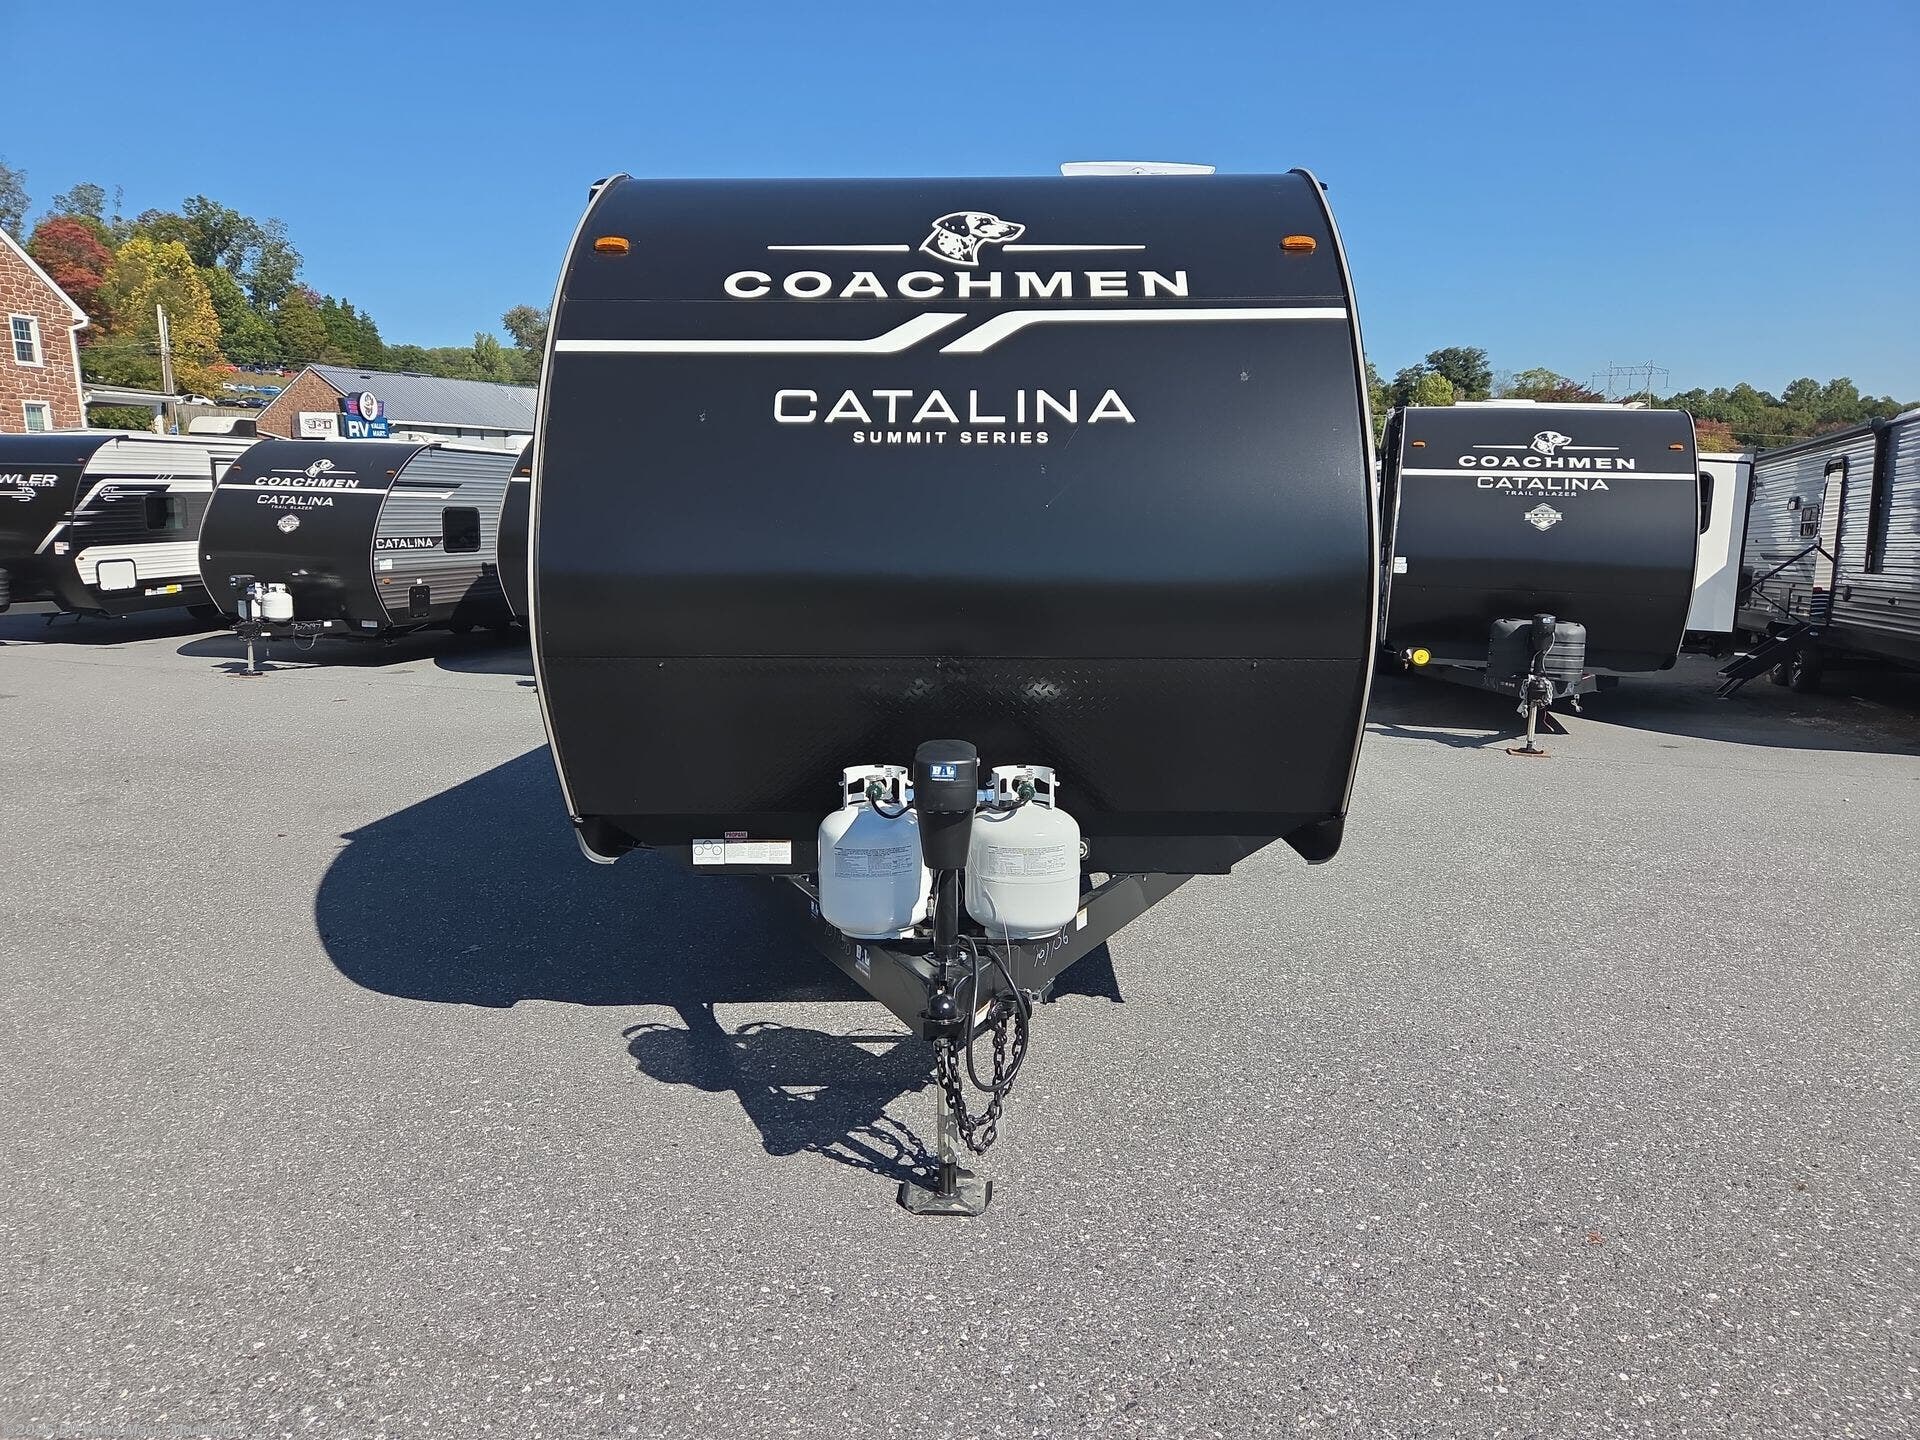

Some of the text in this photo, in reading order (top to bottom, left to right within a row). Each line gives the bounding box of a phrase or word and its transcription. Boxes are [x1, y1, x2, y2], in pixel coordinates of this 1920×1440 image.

[723, 270, 1190, 299] COACHMEN
[773, 389, 1136, 424] CATALINA
[348, 420, 369, 437] RV
[852, 431, 1049, 444] SUMMIT SERIES
[1458, 455, 1636, 470] COACHMEN
[255, 476, 360, 488] COACHMEN
[1477, 476, 1610, 491] CATALINA
[257, 495, 334, 506] CATALINA
[375, 538, 434, 549] CATALINA
